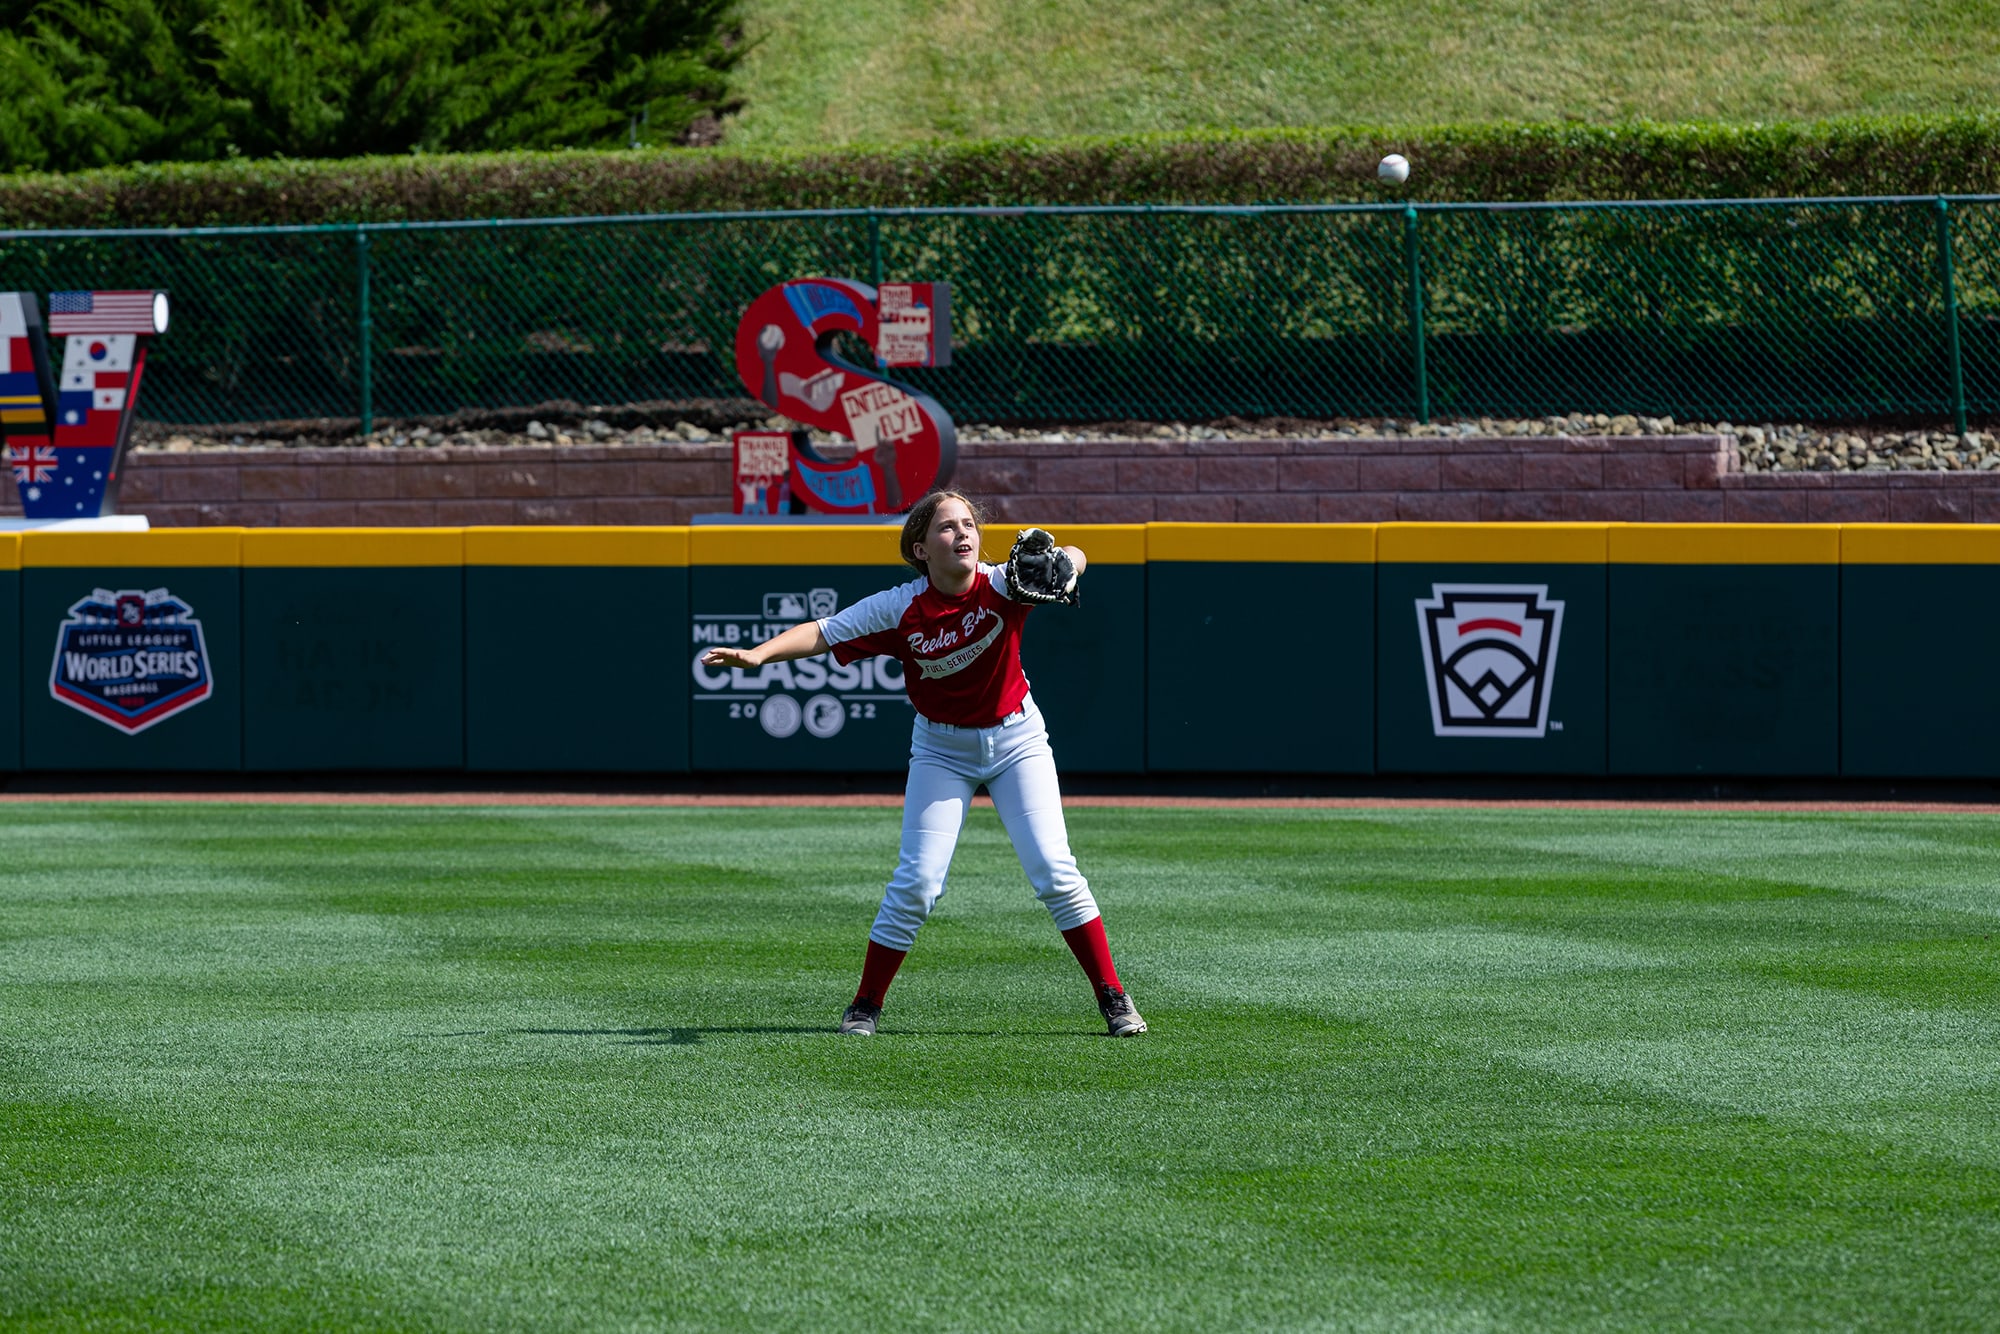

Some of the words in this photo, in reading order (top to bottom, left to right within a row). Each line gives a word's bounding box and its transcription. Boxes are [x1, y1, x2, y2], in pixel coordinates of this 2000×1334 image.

[79, 633, 122, 647] LITTLE
[907, 628, 959, 653] Reeder
[65, 651, 134, 682] WORLD
[134, 650, 199, 679] SERIES
[925, 664, 946, 673] FUEL
[947, 644, 983, 669] SERVICES
[104, 682, 159, 697] BASEBALL
